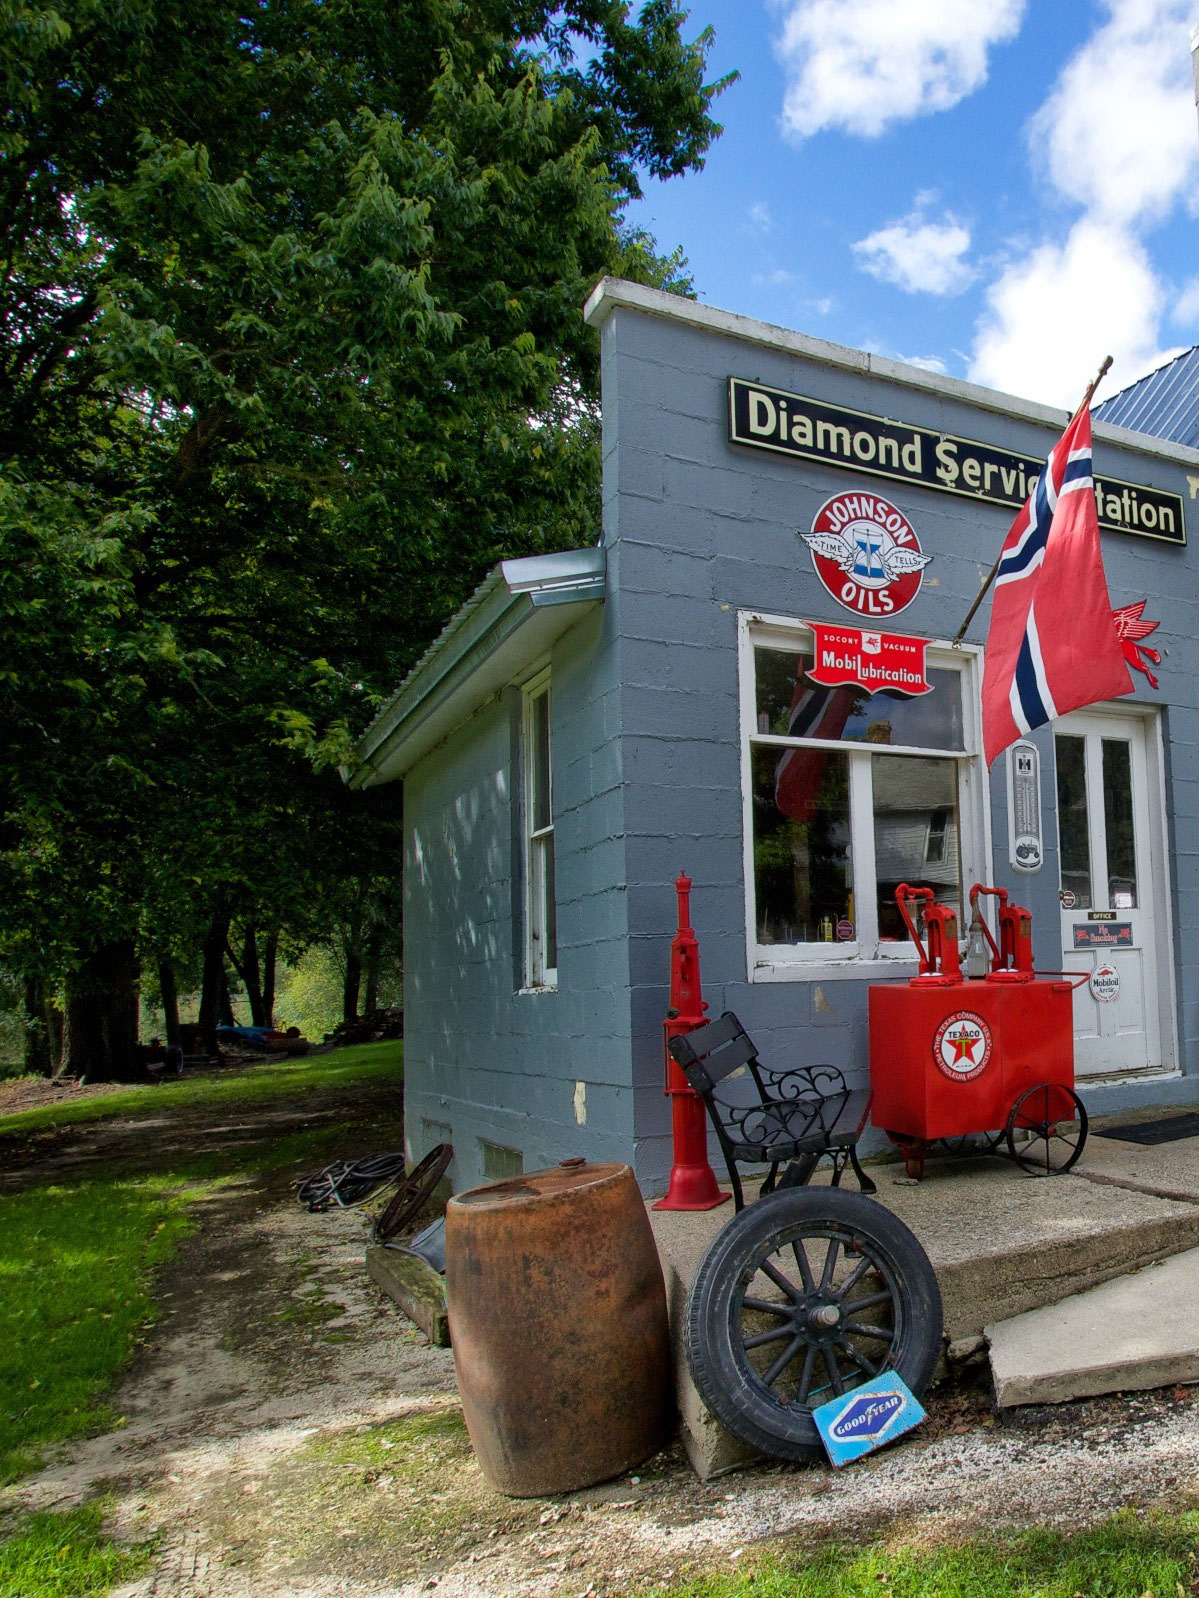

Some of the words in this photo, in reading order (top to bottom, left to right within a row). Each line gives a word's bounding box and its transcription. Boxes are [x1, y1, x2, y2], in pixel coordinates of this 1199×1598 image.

[748, 390, 922, 474] Diamond
[935, 441, 1040, 500] Servic
[1094, 482, 1176, 533] tation
[825, 496, 914, 545] JOHNSON
[841, 582, 894, 613] OILS
[823, 634, 859, 645] SOCONY
[883, 642, 916, 653] VACUUM
[1093, 978, 1119, 988] Mobiloil
[939, 1015, 956, 1033] TEXAS
[956, 1011, 984, 1027] COMPANY
[948, 1030, 980, 1039] TEXACO
[936, 1053, 967, 1081] PETROLEUM
[967, 1051, 991, 1079] PRODUCTS
